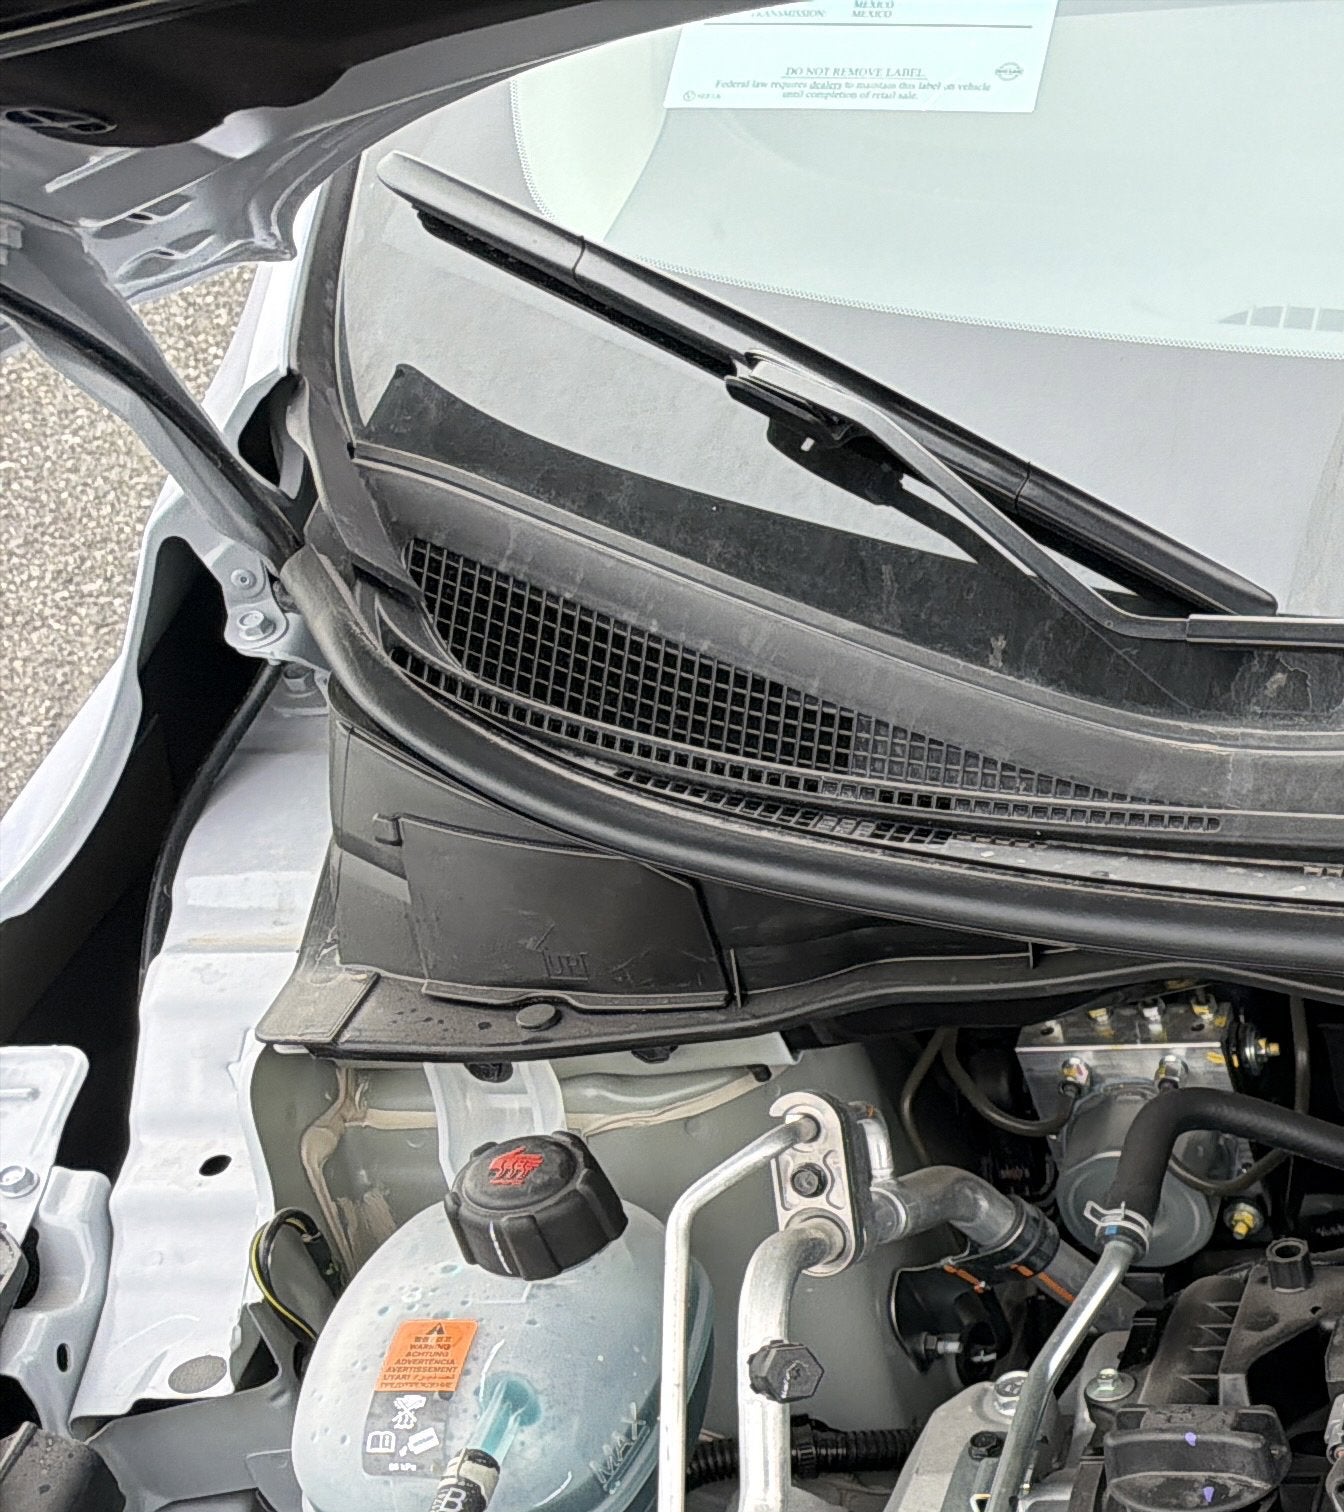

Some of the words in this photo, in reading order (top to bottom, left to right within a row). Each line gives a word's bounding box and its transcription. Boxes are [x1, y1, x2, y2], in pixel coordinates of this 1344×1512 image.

[852, 10, 893, 18] MEXICO
[785, 67, 803, 76] DO
[806, 67, 830, 76] NOT
[833, 67, 883, 77] REMOVE
